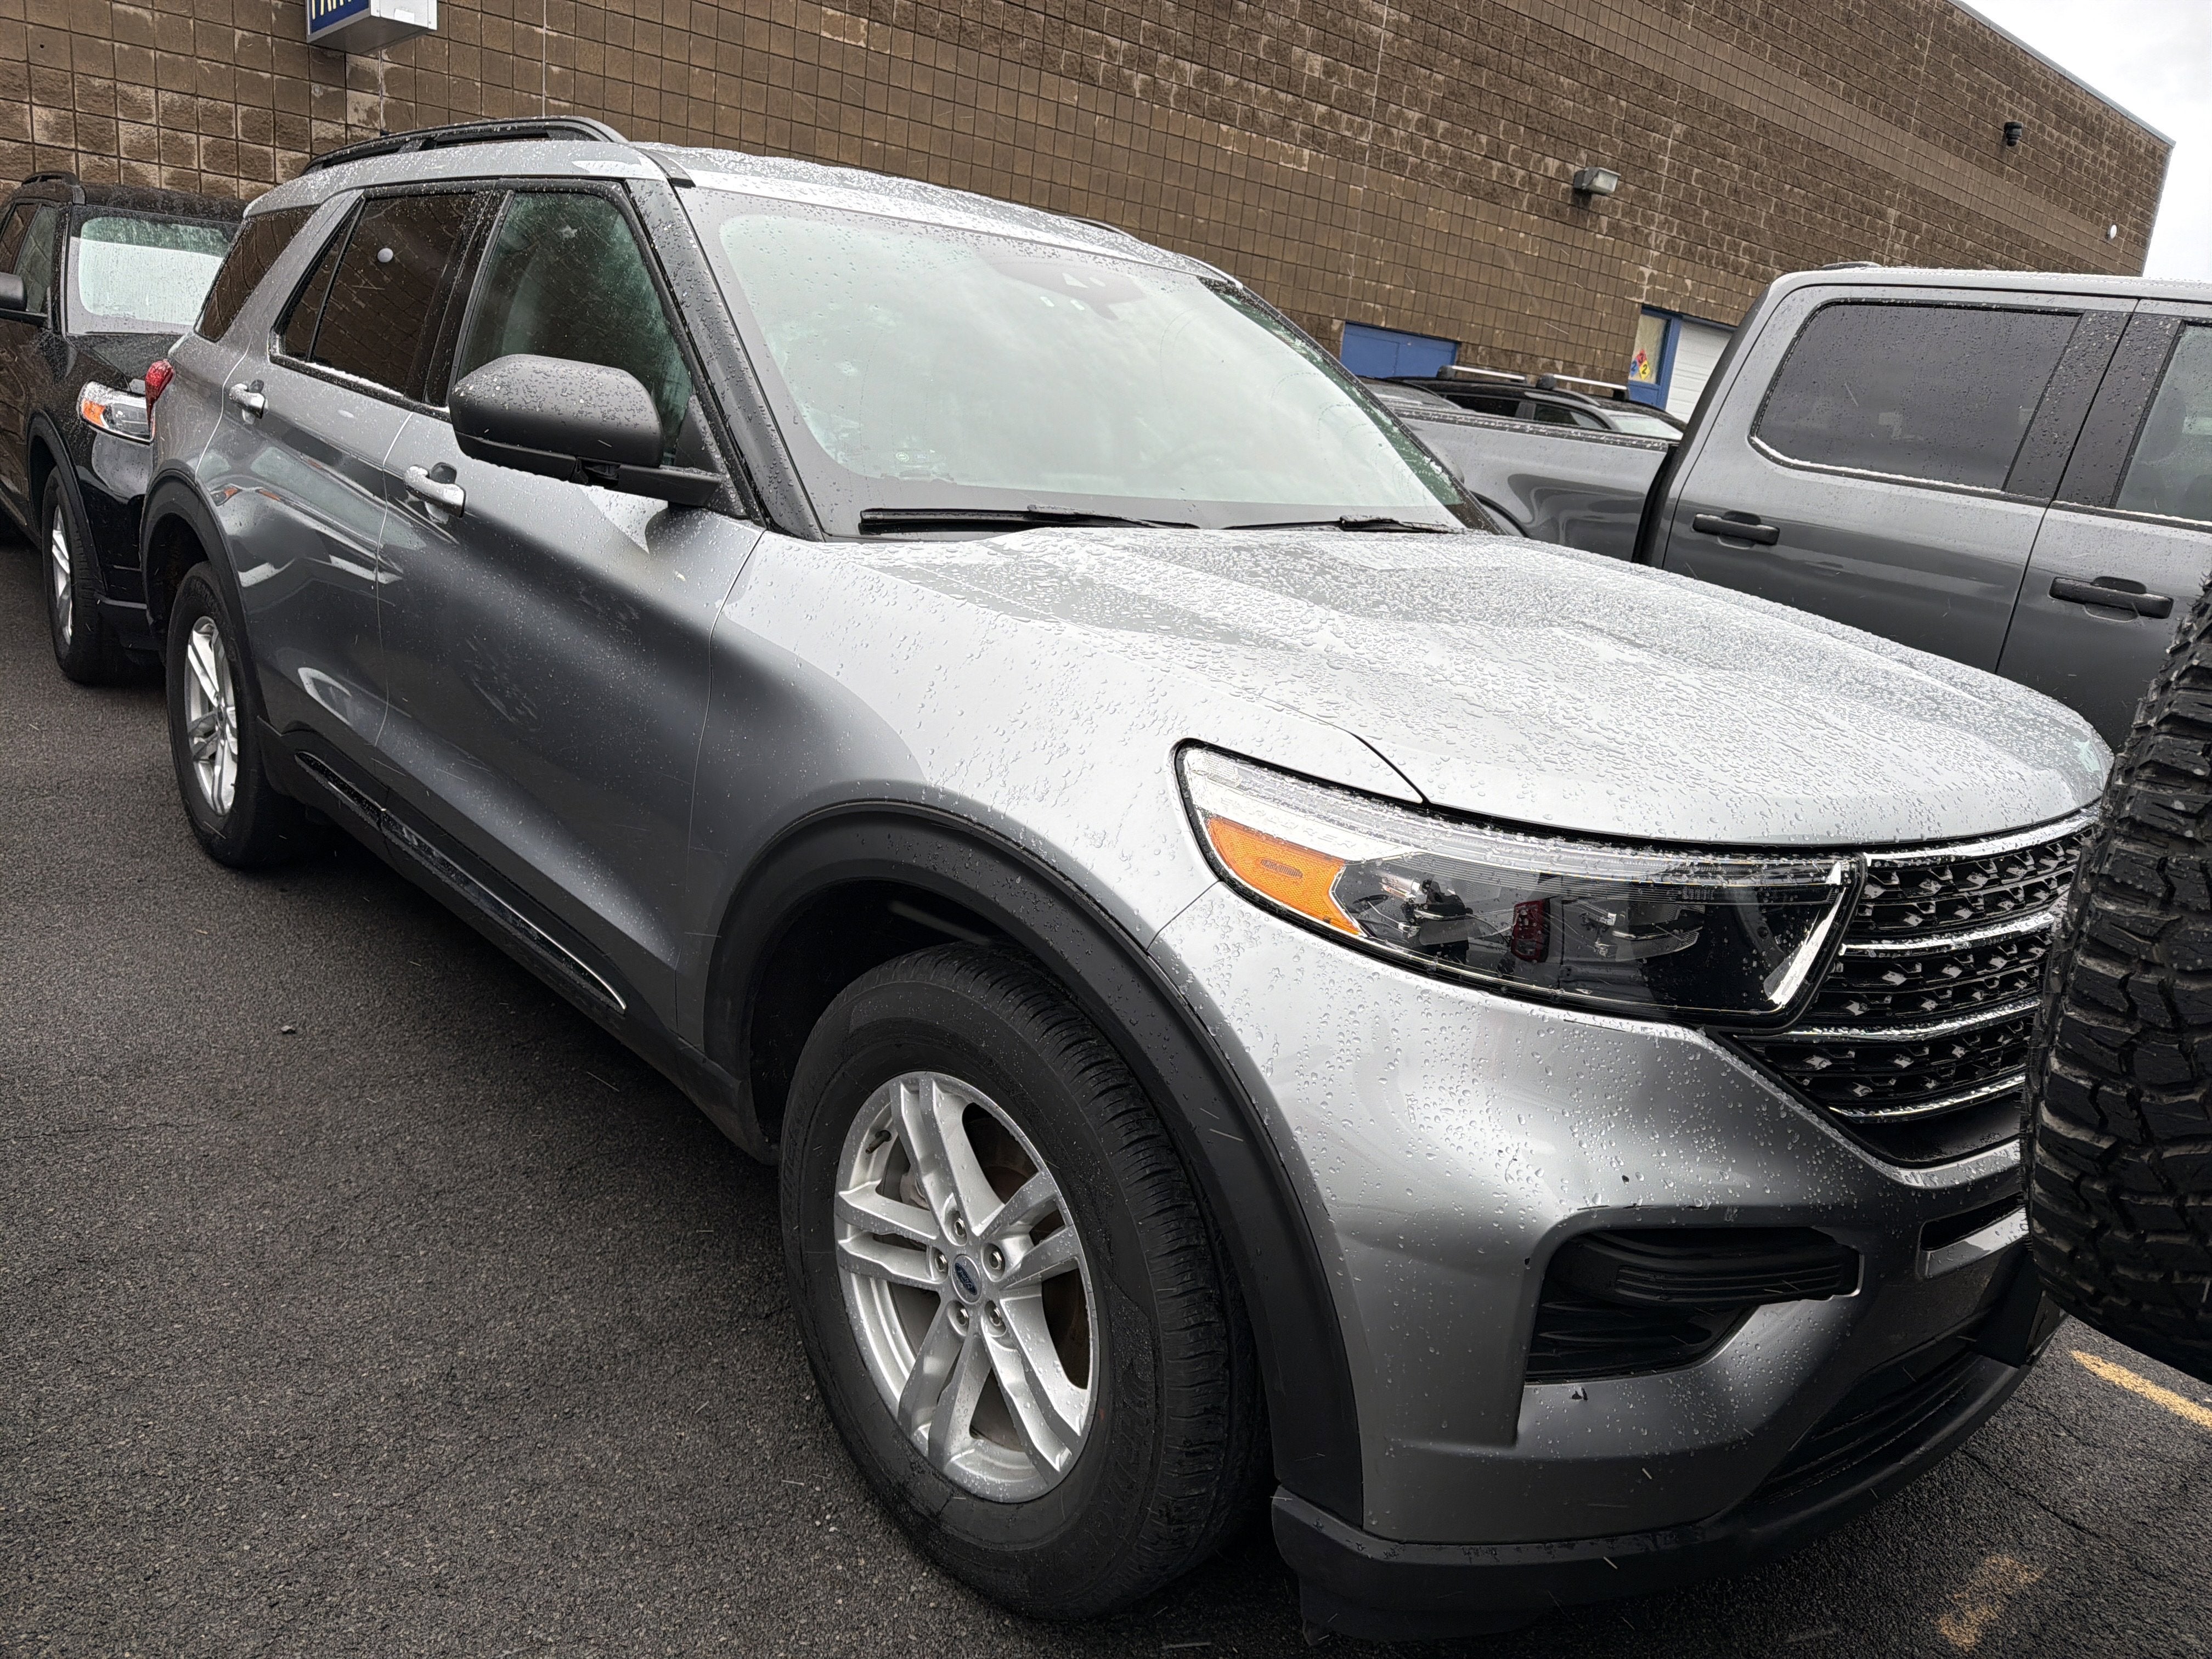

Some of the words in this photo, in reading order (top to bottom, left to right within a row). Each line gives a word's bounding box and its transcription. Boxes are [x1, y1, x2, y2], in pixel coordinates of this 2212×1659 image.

[1638, 353, 1644, 364] 3
[1631, 360, 1637, 371] 2
[1641, 364, 1647, 375] 2
[956, 1267, 974, 1291] Ford
